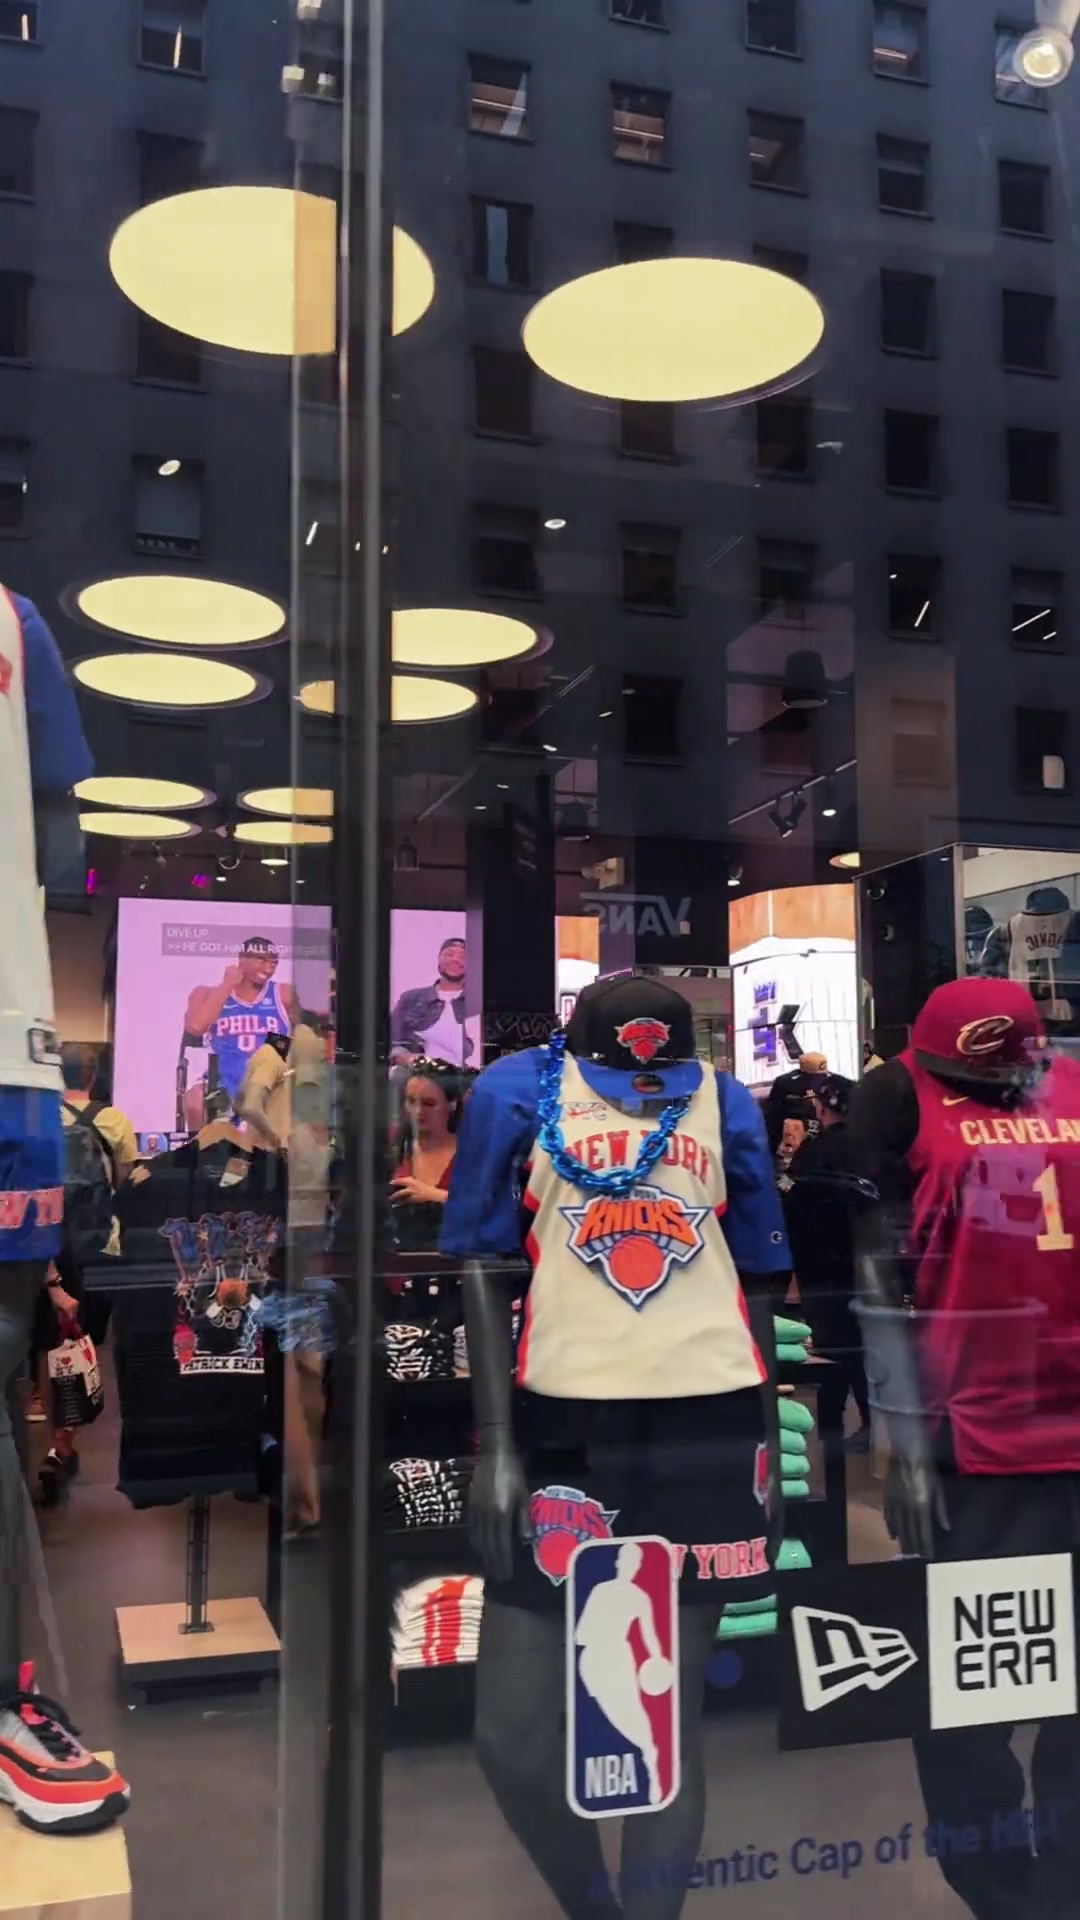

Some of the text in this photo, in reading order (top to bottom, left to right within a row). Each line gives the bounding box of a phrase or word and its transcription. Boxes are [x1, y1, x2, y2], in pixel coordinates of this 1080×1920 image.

[199, 942, 223, 953] GOT
[246, 942, 266, 953] ALL
[216, 1014, 280, 1036] PHILA
[956, 1015, 1014, 1056] C
[574, 1198, 698, 1249] KNICKS
[691, 1536, 770, 1580] YORK
[954, 1587, 1056, 1642] NEW
[955, 1637, 1058, 1692] ERA
[584, 1752, 639, 1800] NBA
[588, 1843, 780, 1902] entic
[790, 1836, 864, 1880] Cap
[873, 1821, 914, 1865] of
[922, 1817, 982, 1858] the
